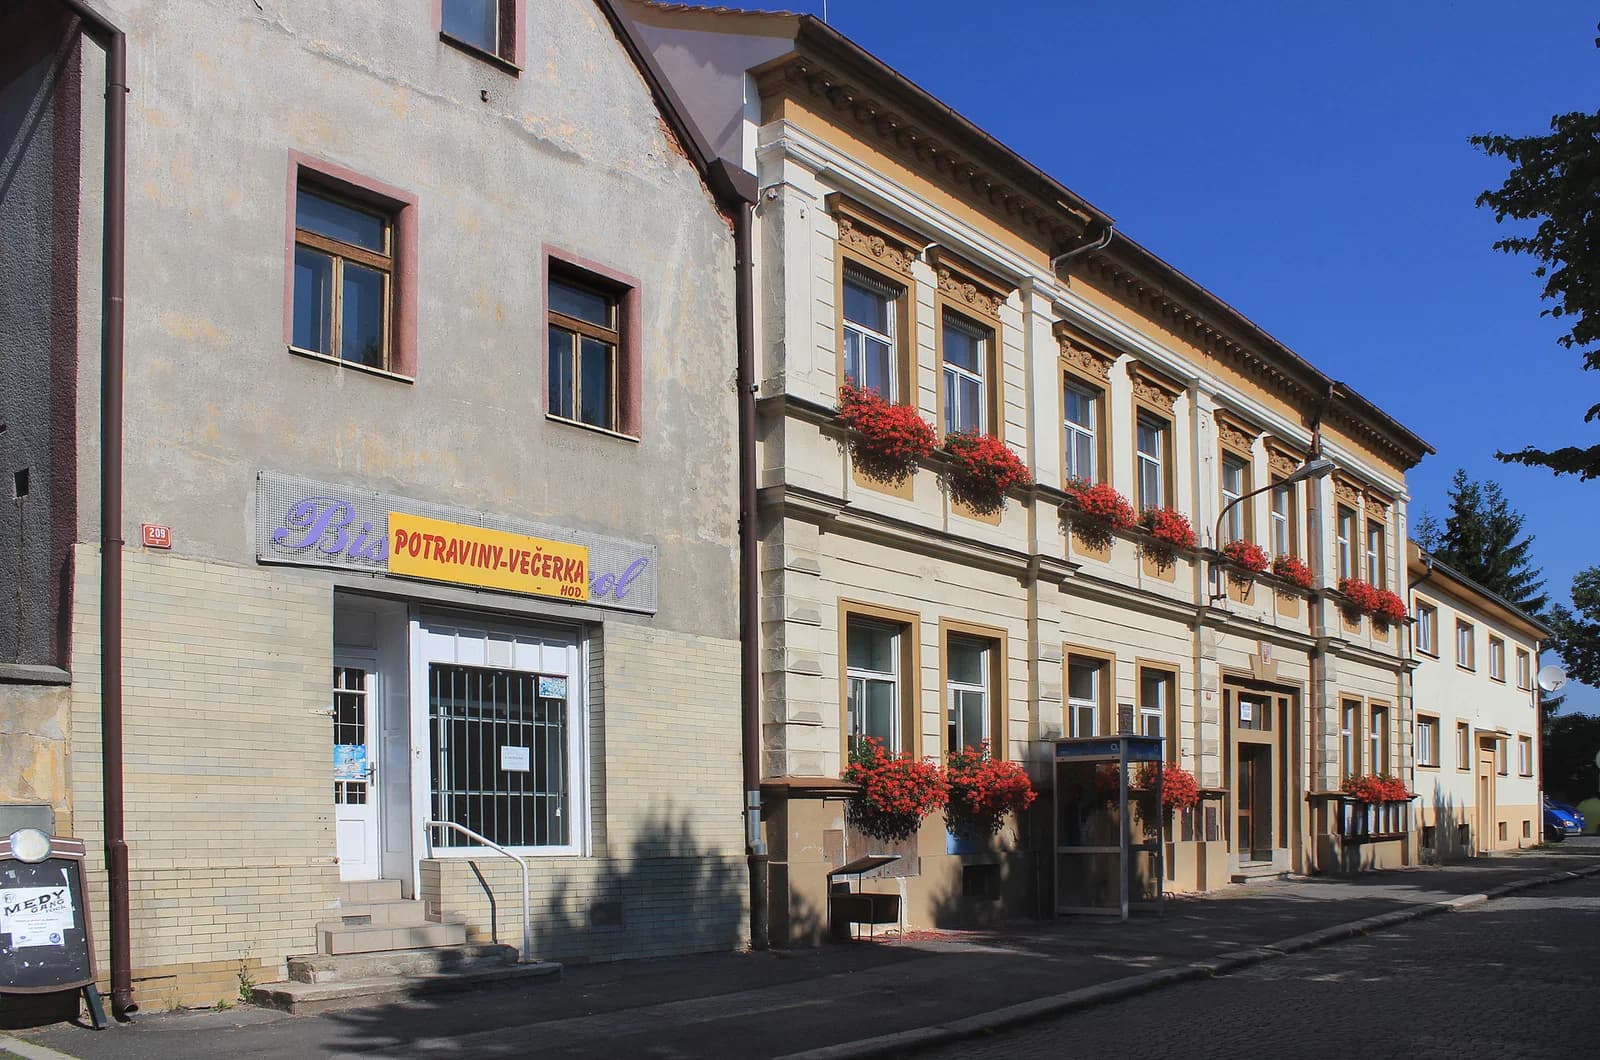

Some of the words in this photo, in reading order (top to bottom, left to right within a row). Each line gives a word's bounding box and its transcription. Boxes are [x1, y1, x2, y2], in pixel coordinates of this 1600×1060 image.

[149, 527, 166, 539] 209
[273, 496, 389, 561] Bis
[394, 528, 585, 585] POTRAVINY-VEČERKA
[560, 584, 585, 599] HOD.
[4, 889, 64, 917] MEDY
